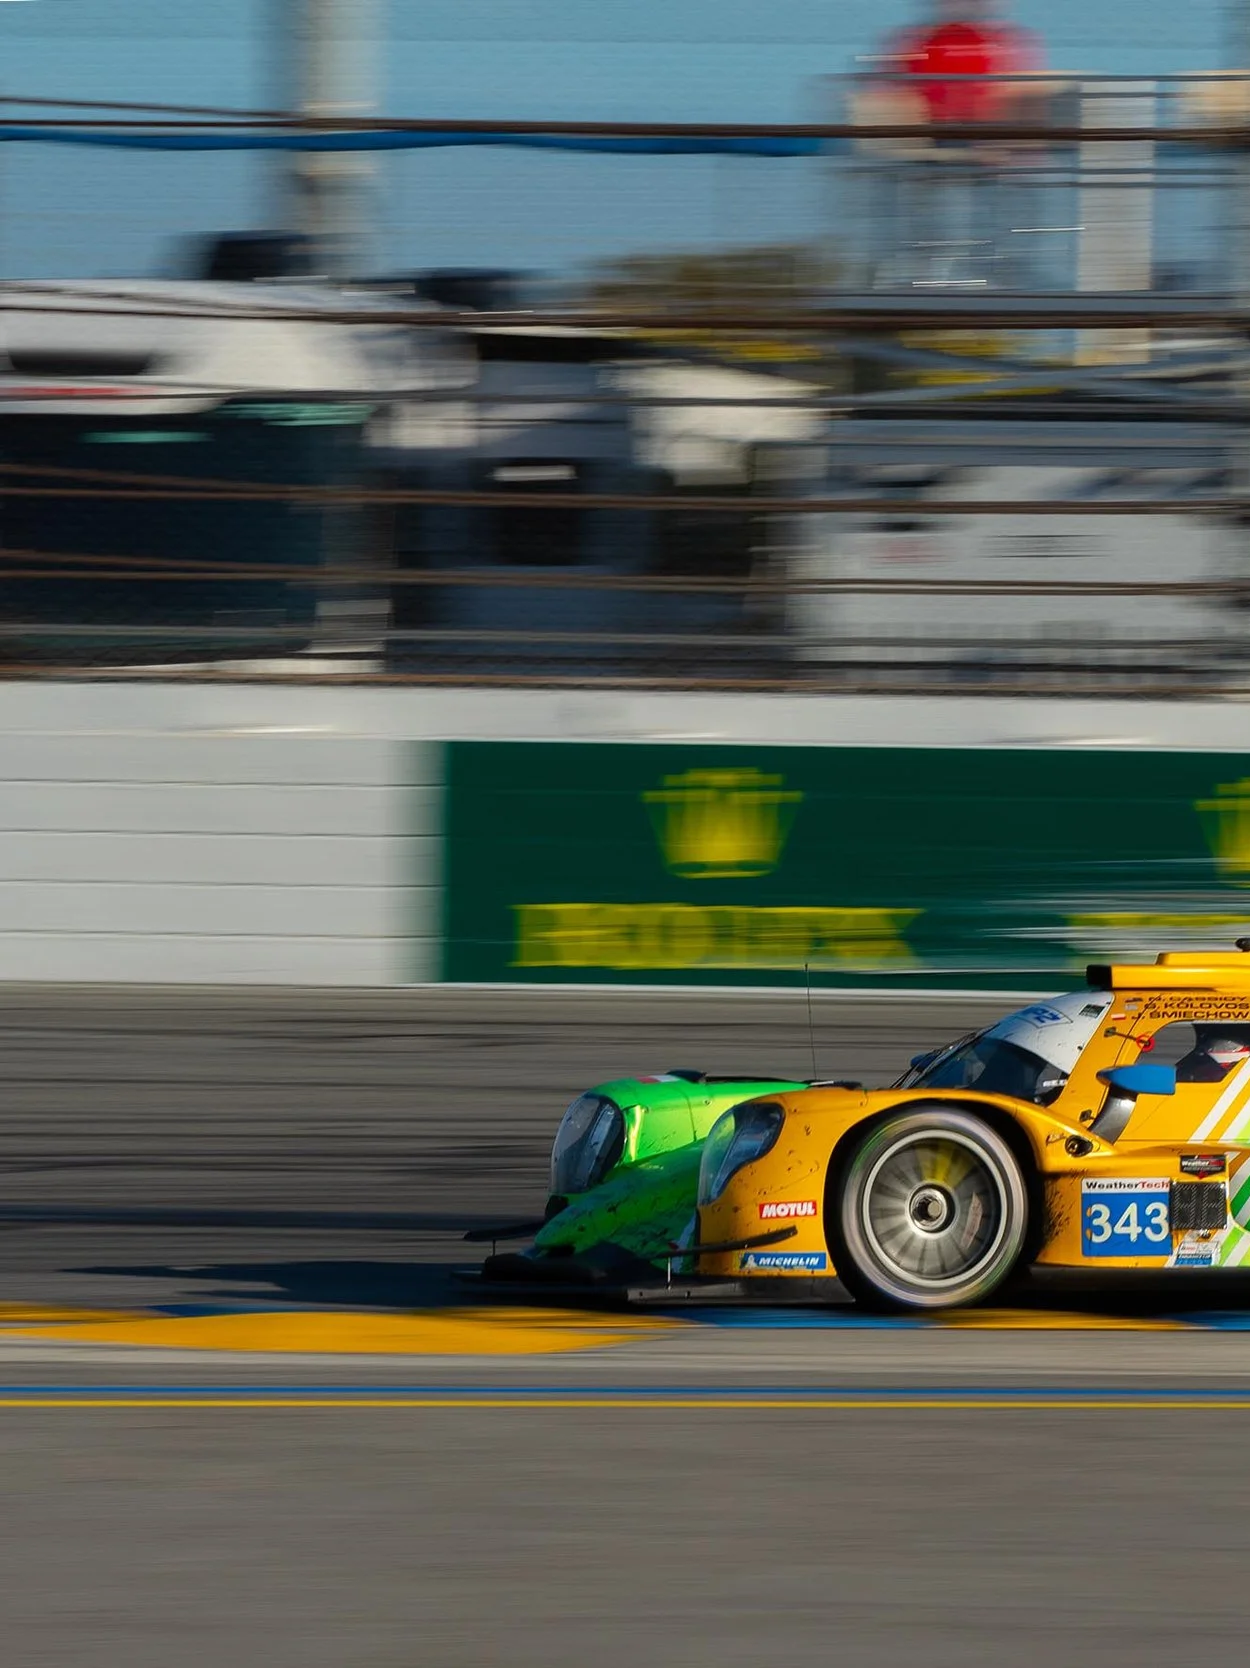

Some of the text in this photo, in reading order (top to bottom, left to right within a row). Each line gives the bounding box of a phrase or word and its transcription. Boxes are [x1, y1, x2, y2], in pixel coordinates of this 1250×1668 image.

[1086, 1181, 1169, 1190] WeatherTech
[761, 1201, 816, 1219] MOTUL
[1086, 1201, 1170, 1244] 343
[758, 1257, 819, 1267] MICHELIN
